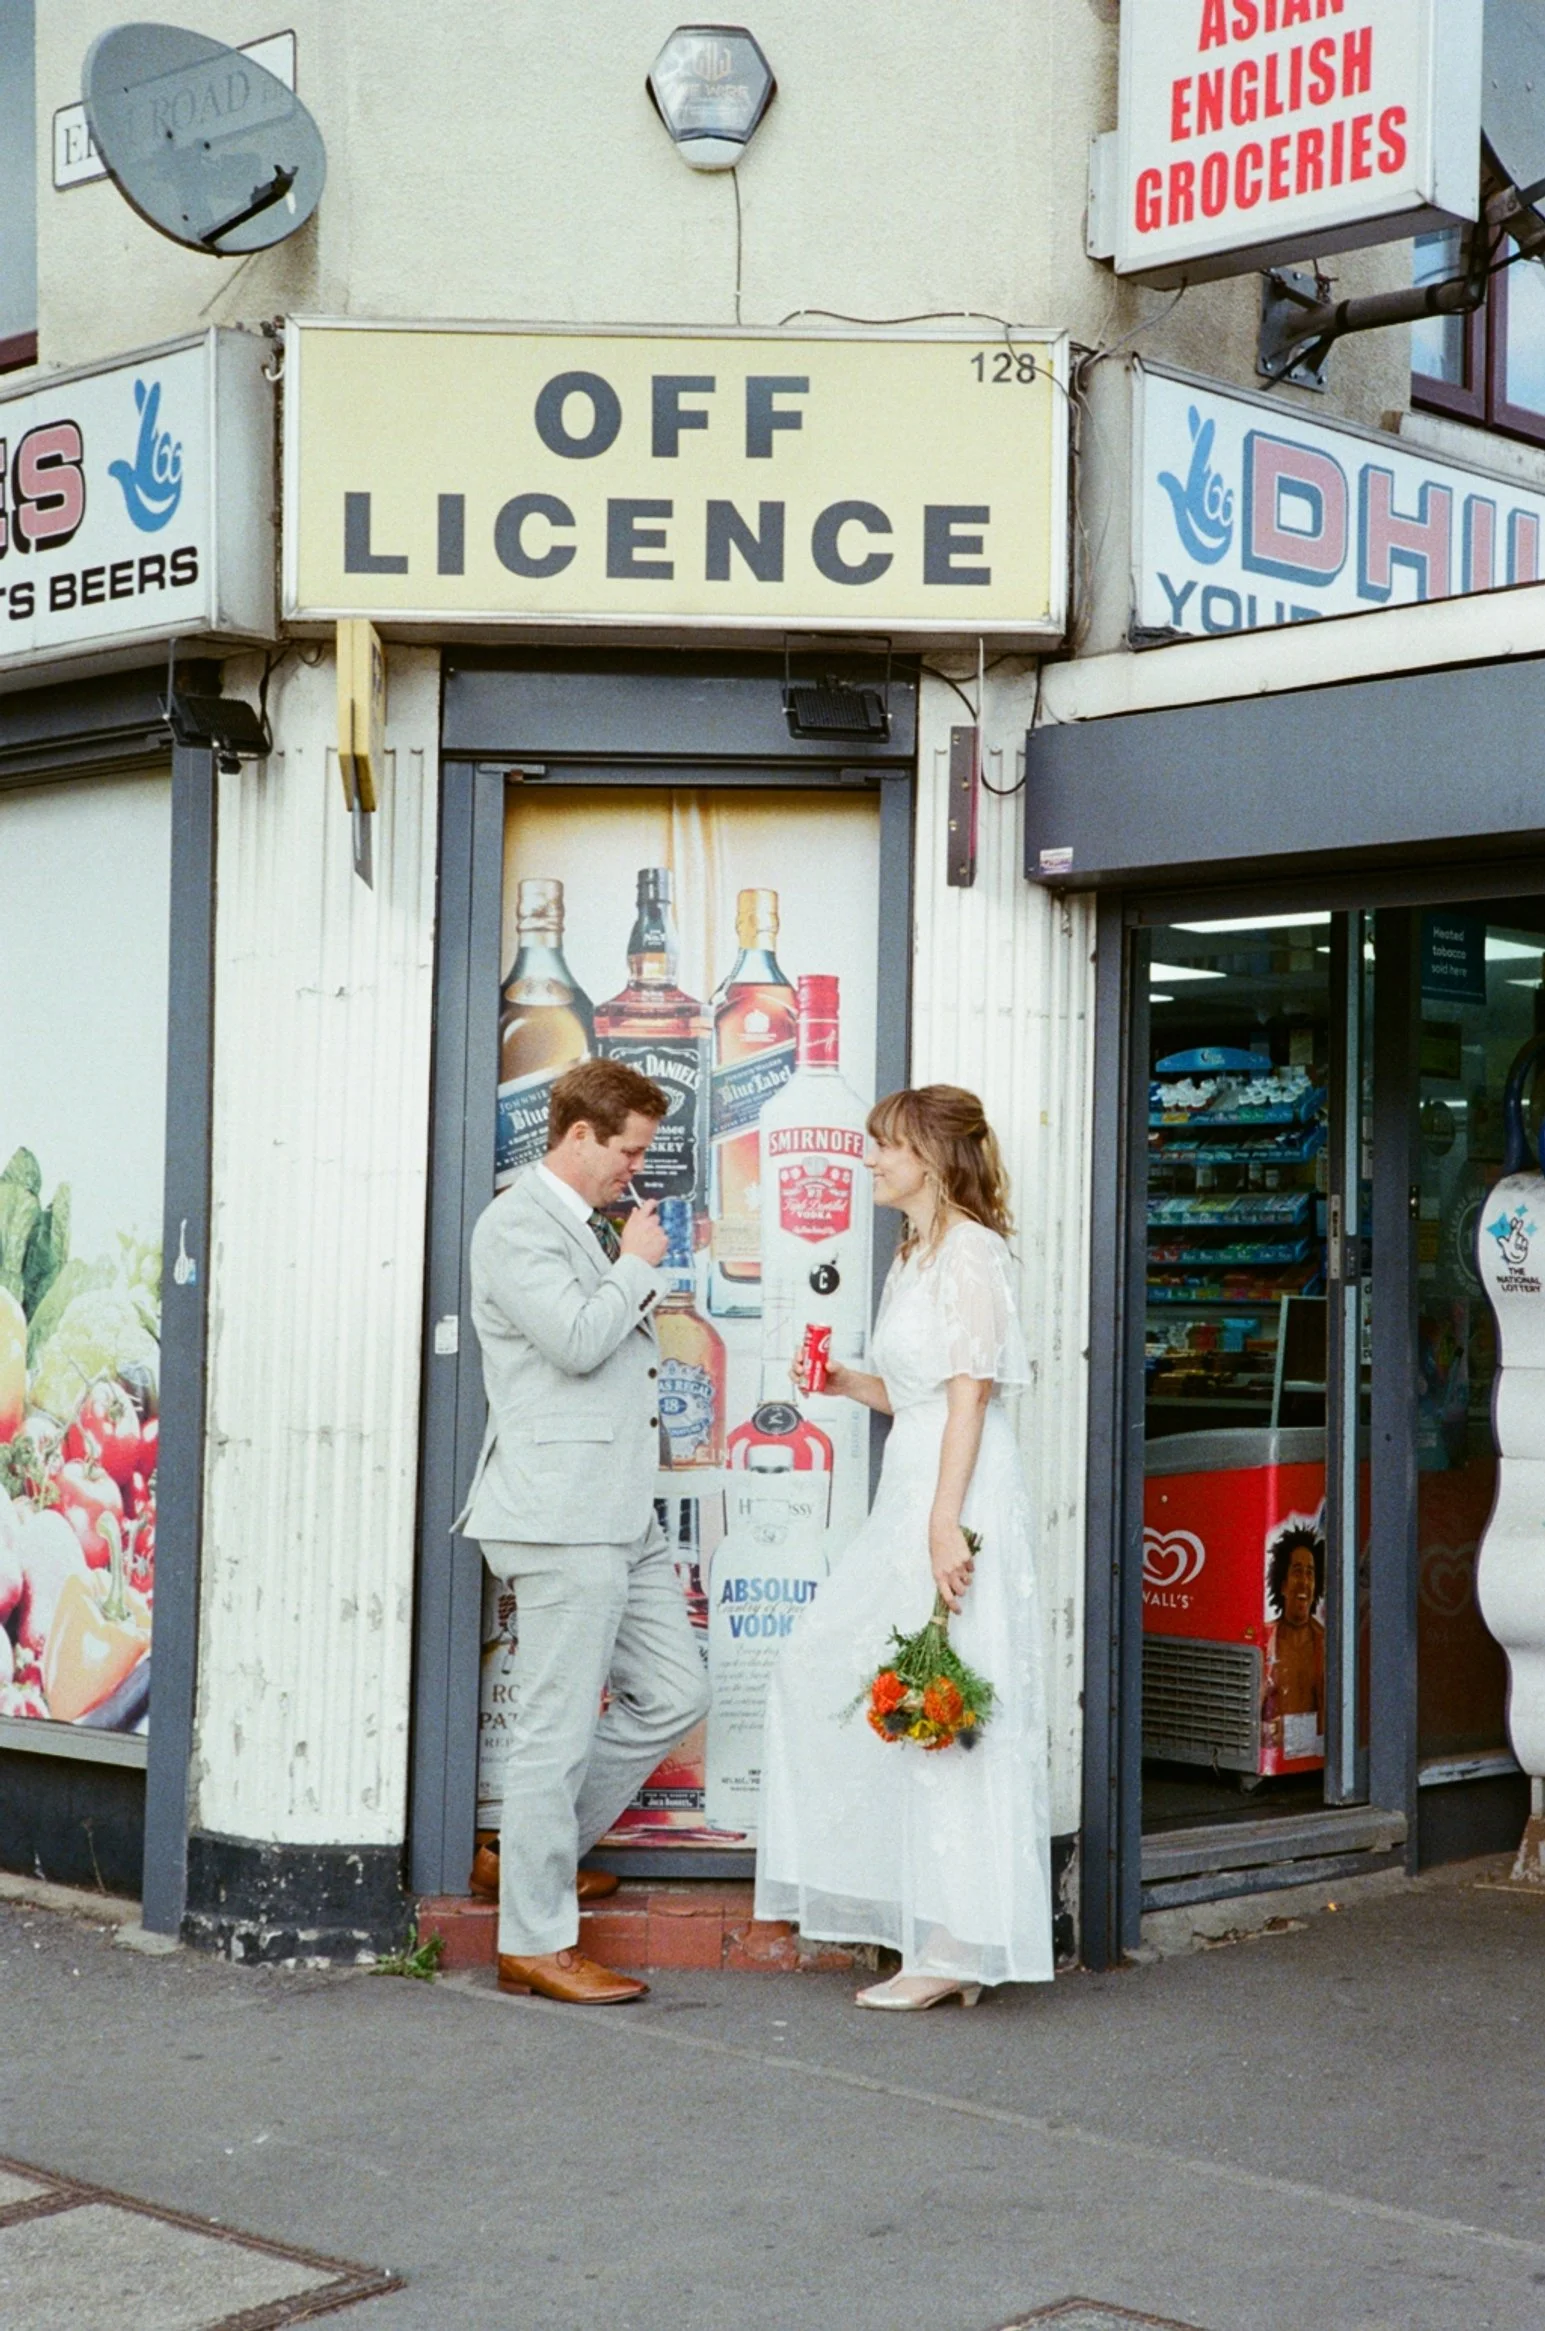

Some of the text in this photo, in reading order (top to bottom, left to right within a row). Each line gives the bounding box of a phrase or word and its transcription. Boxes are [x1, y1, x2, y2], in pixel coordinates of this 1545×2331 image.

[1171, 26, 1372, 142] ENGLISH
[1134, 106, 1407, 233] GROCERIES
[969, 352, 1036, 385] 128
[534, 371, 810, 459] OFF
[343, 491, 992, 586] LICENCE
[49, 545, 198, 612] BEERS
[1432, 945, 1467, 960] tobacco
[769, 1128, 861, 1155] SMIRNOFF
[1496, 1275, 1542, 1286] NATIONAL
[1508, 1267, 1526, 1276] THE
[1500, 1284, 1541, 1293] LOTTERY
[664, 1399, 680, 1413] 18
[721, 1578, 818, 1604] ABSOLUT
[729, 1614, 793, 1638] VODK
